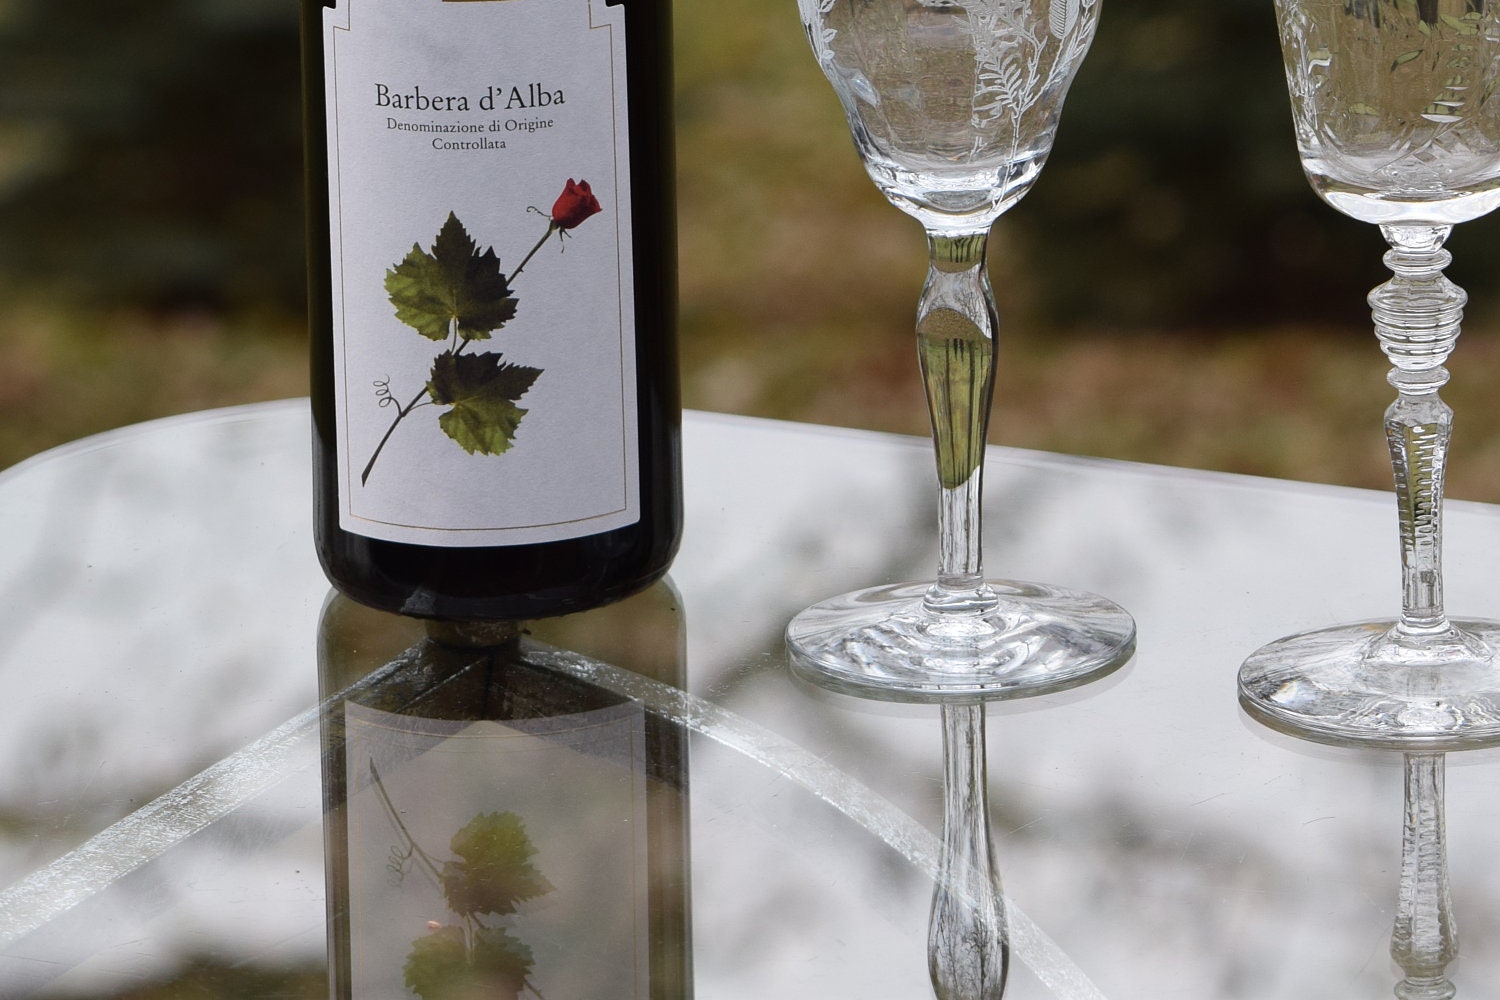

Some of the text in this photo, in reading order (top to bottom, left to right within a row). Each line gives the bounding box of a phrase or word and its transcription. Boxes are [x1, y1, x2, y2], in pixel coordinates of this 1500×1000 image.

[374, 82, 566, 111] Barbera d'Alba
[387, 117, 554, 133] Denominazione di Origine
[432, 137, 507, 150] Controllata
